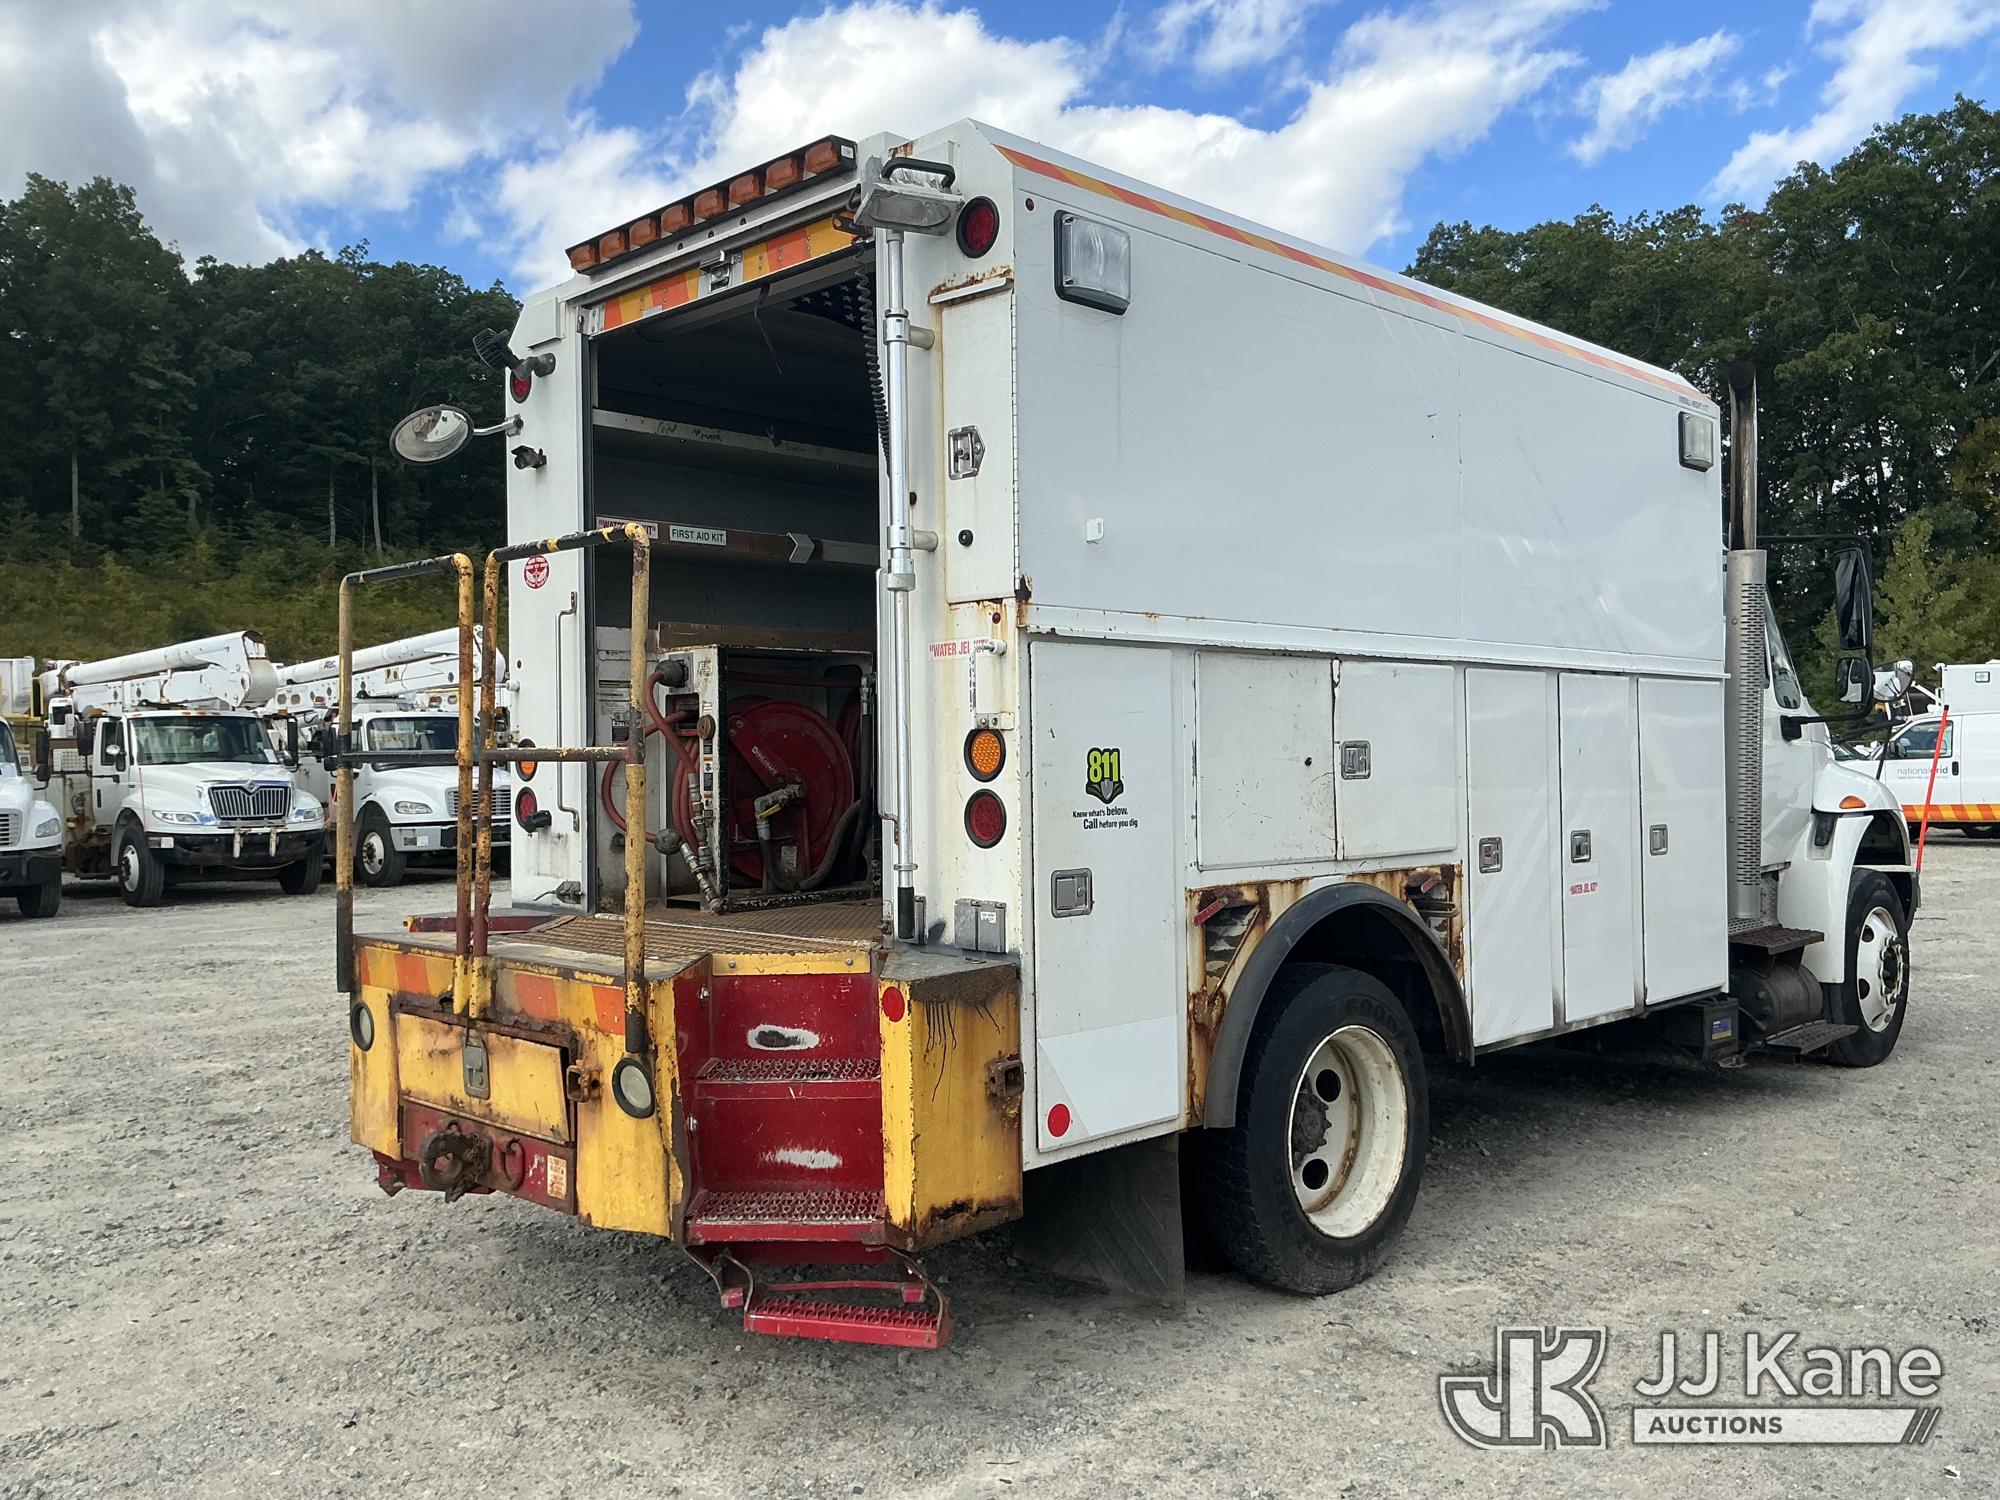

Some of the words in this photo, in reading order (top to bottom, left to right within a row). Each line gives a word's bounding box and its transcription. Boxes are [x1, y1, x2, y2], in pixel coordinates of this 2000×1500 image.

[672, 529, 694, 540] FIRST
[696, 532, 710, 541] AID
[711, 533, 724, 543] KIT
[929, 642, 957, 658] "WATER
[1088, 748, 1120, 783] 811
[1072, 810, 1088, 818] Know
[1088, 809, 1106, 817] what's
[1106, 806, 1128, 816] below.
[1083, 818, 1098, 829] Call
[1099, 819, 1117, 829] before
[1118, 820, 1128, 829] you
[1129, 818, 1138, 828] dig
